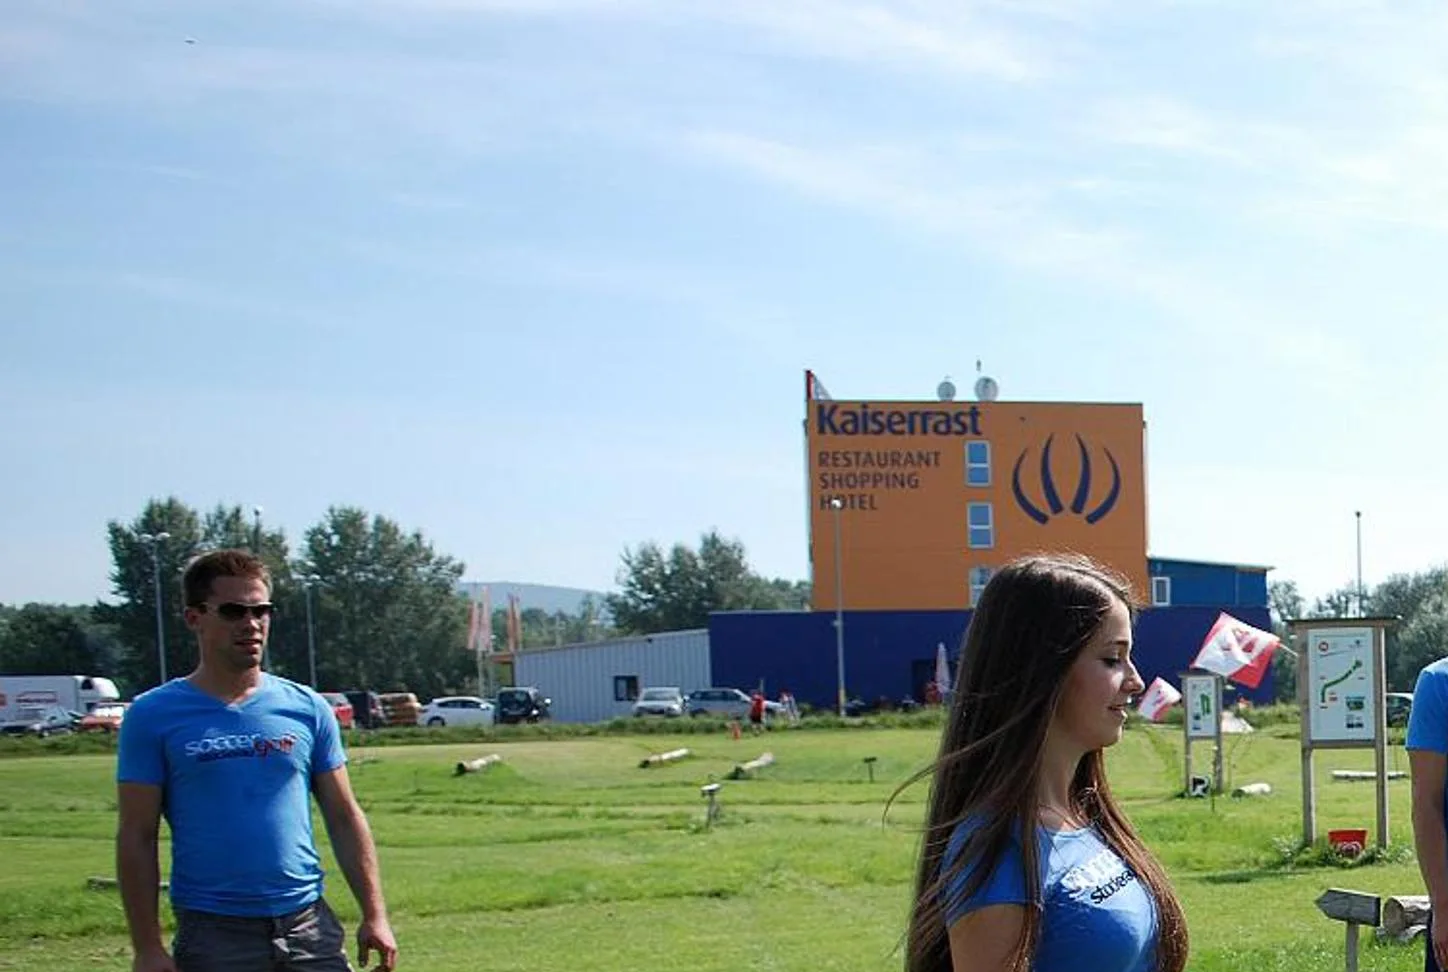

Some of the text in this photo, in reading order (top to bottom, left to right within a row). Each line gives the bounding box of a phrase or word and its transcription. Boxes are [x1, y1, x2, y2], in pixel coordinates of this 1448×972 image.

[816, 404, 982, 436] Kaiserrast
[818, 451, 941, 468] RESTAURANT
[820, 473, 920, 489] SHOPPING
[820, 494, 877, 510] HOTEL
